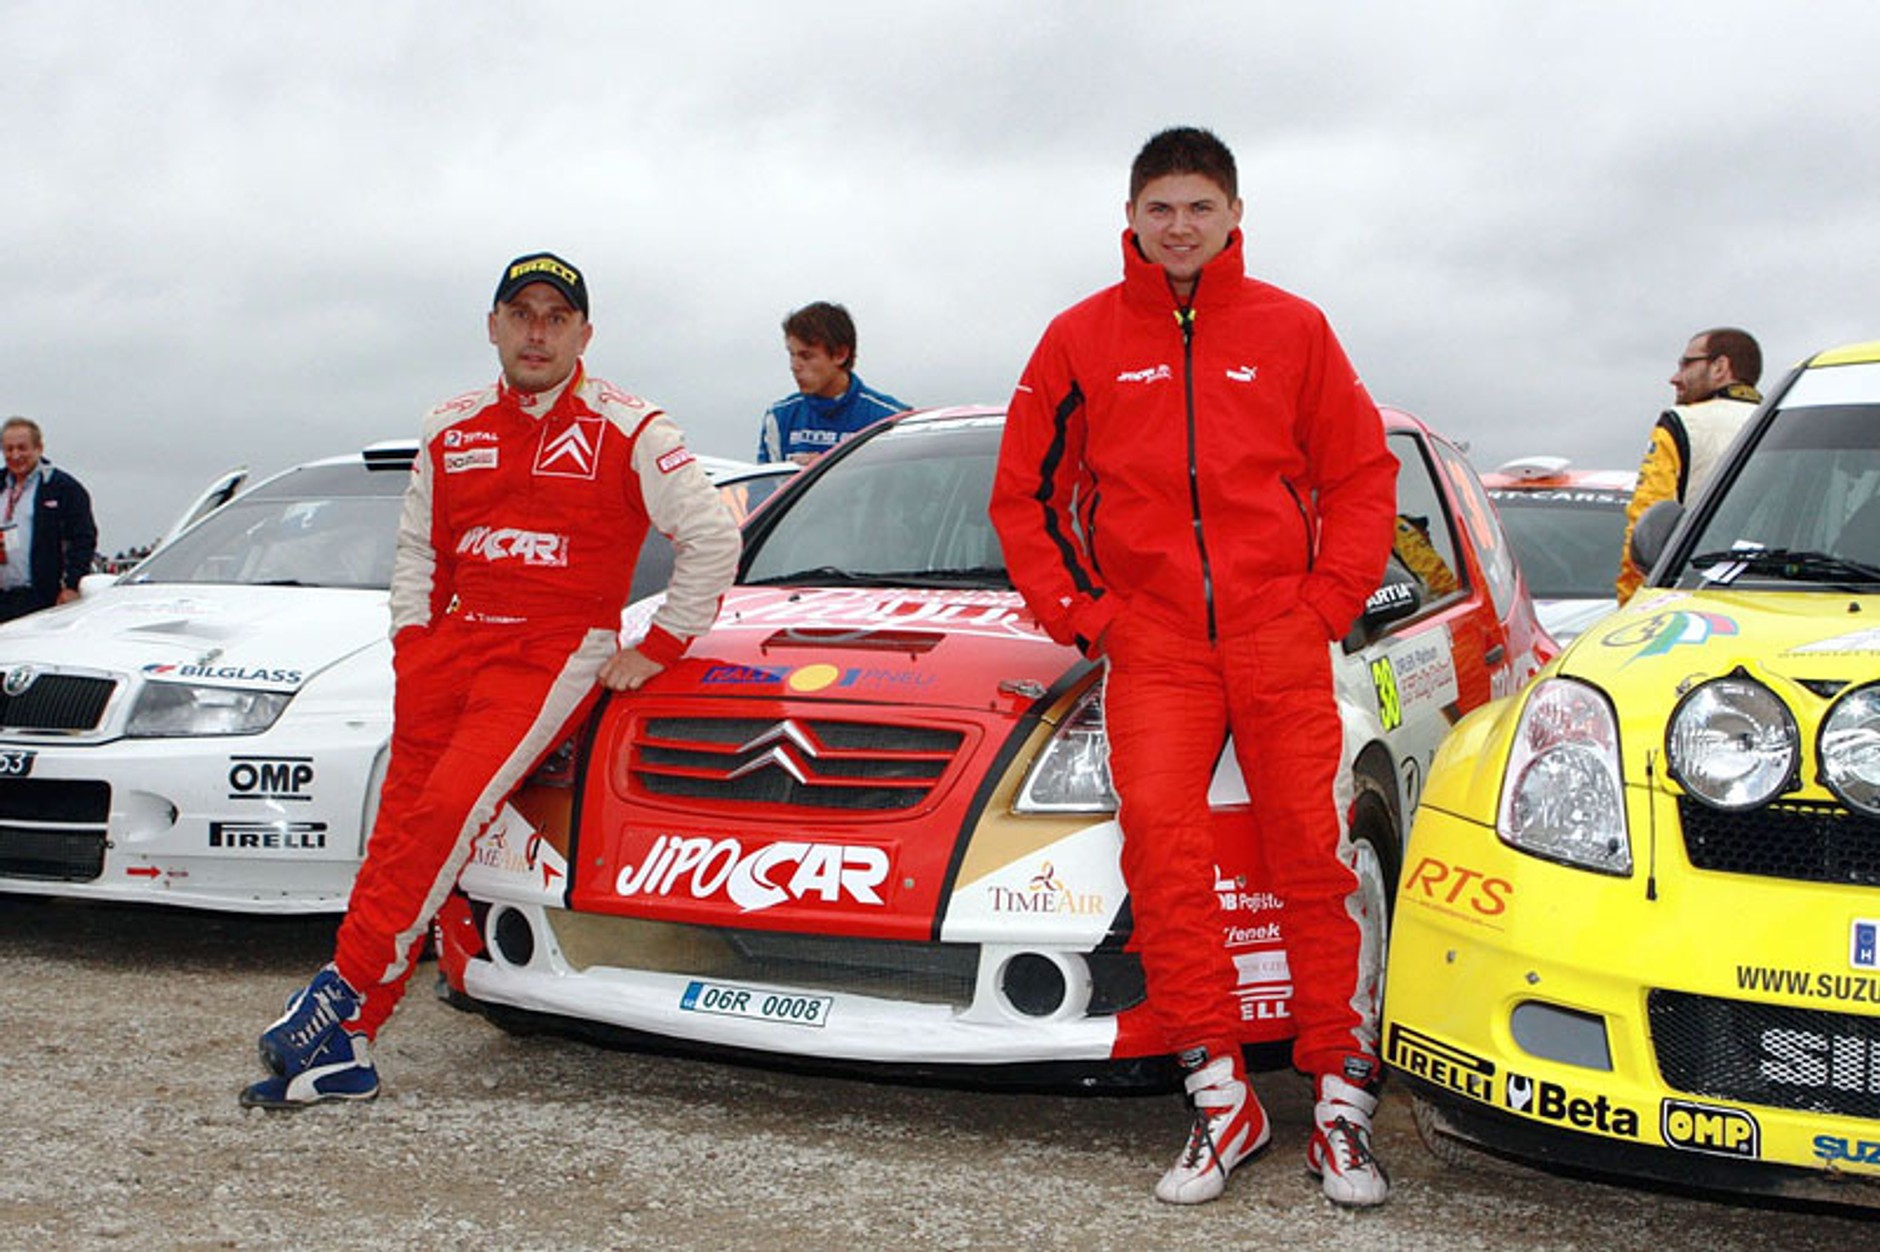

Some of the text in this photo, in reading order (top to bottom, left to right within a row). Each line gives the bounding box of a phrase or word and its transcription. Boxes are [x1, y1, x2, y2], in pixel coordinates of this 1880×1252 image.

[178, 663, 303, 684] BILGLASS
[228, 763, 314, 793] OMP
[209, 822, 328, 848] PIRELLI
[1405, 857, 1513, 916] RTS
[1861, 949, 1872, 960] H
[703, 989, 821, 1021] 06R 0008
[1388, 1021, 1496, 1102] PIRELLI
[1540, 1081, 1639, 1138] Beta
[1668, 1110, 1751, 1149] OMP
